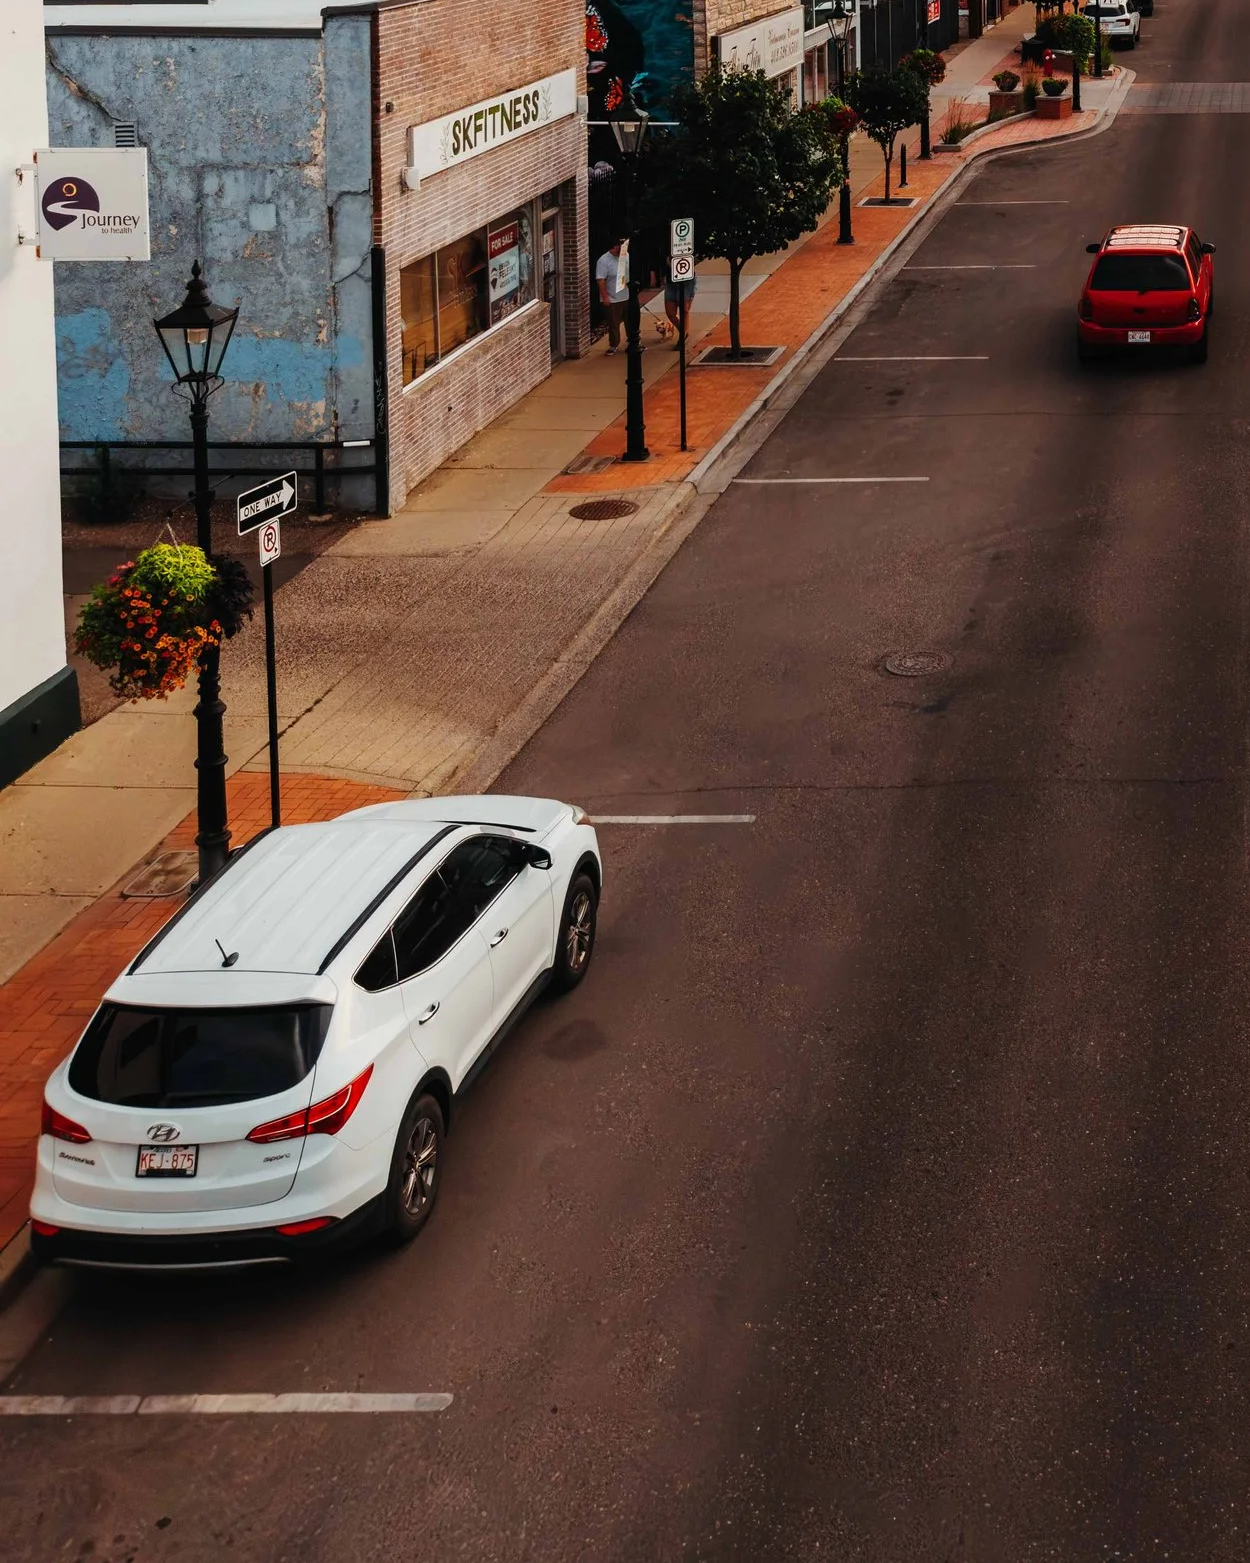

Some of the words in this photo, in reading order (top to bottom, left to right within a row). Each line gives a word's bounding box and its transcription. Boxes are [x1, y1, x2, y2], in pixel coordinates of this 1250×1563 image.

[452, 89, 540, 156] SKFITNESS
[81, 213, 140, 229] Journey
[491, 238, 502, 252] FOR
[502, 231, 514, 247] SALE
[243, 501, 260, 518] ONE
[264, 491, 281, 509] WAY
